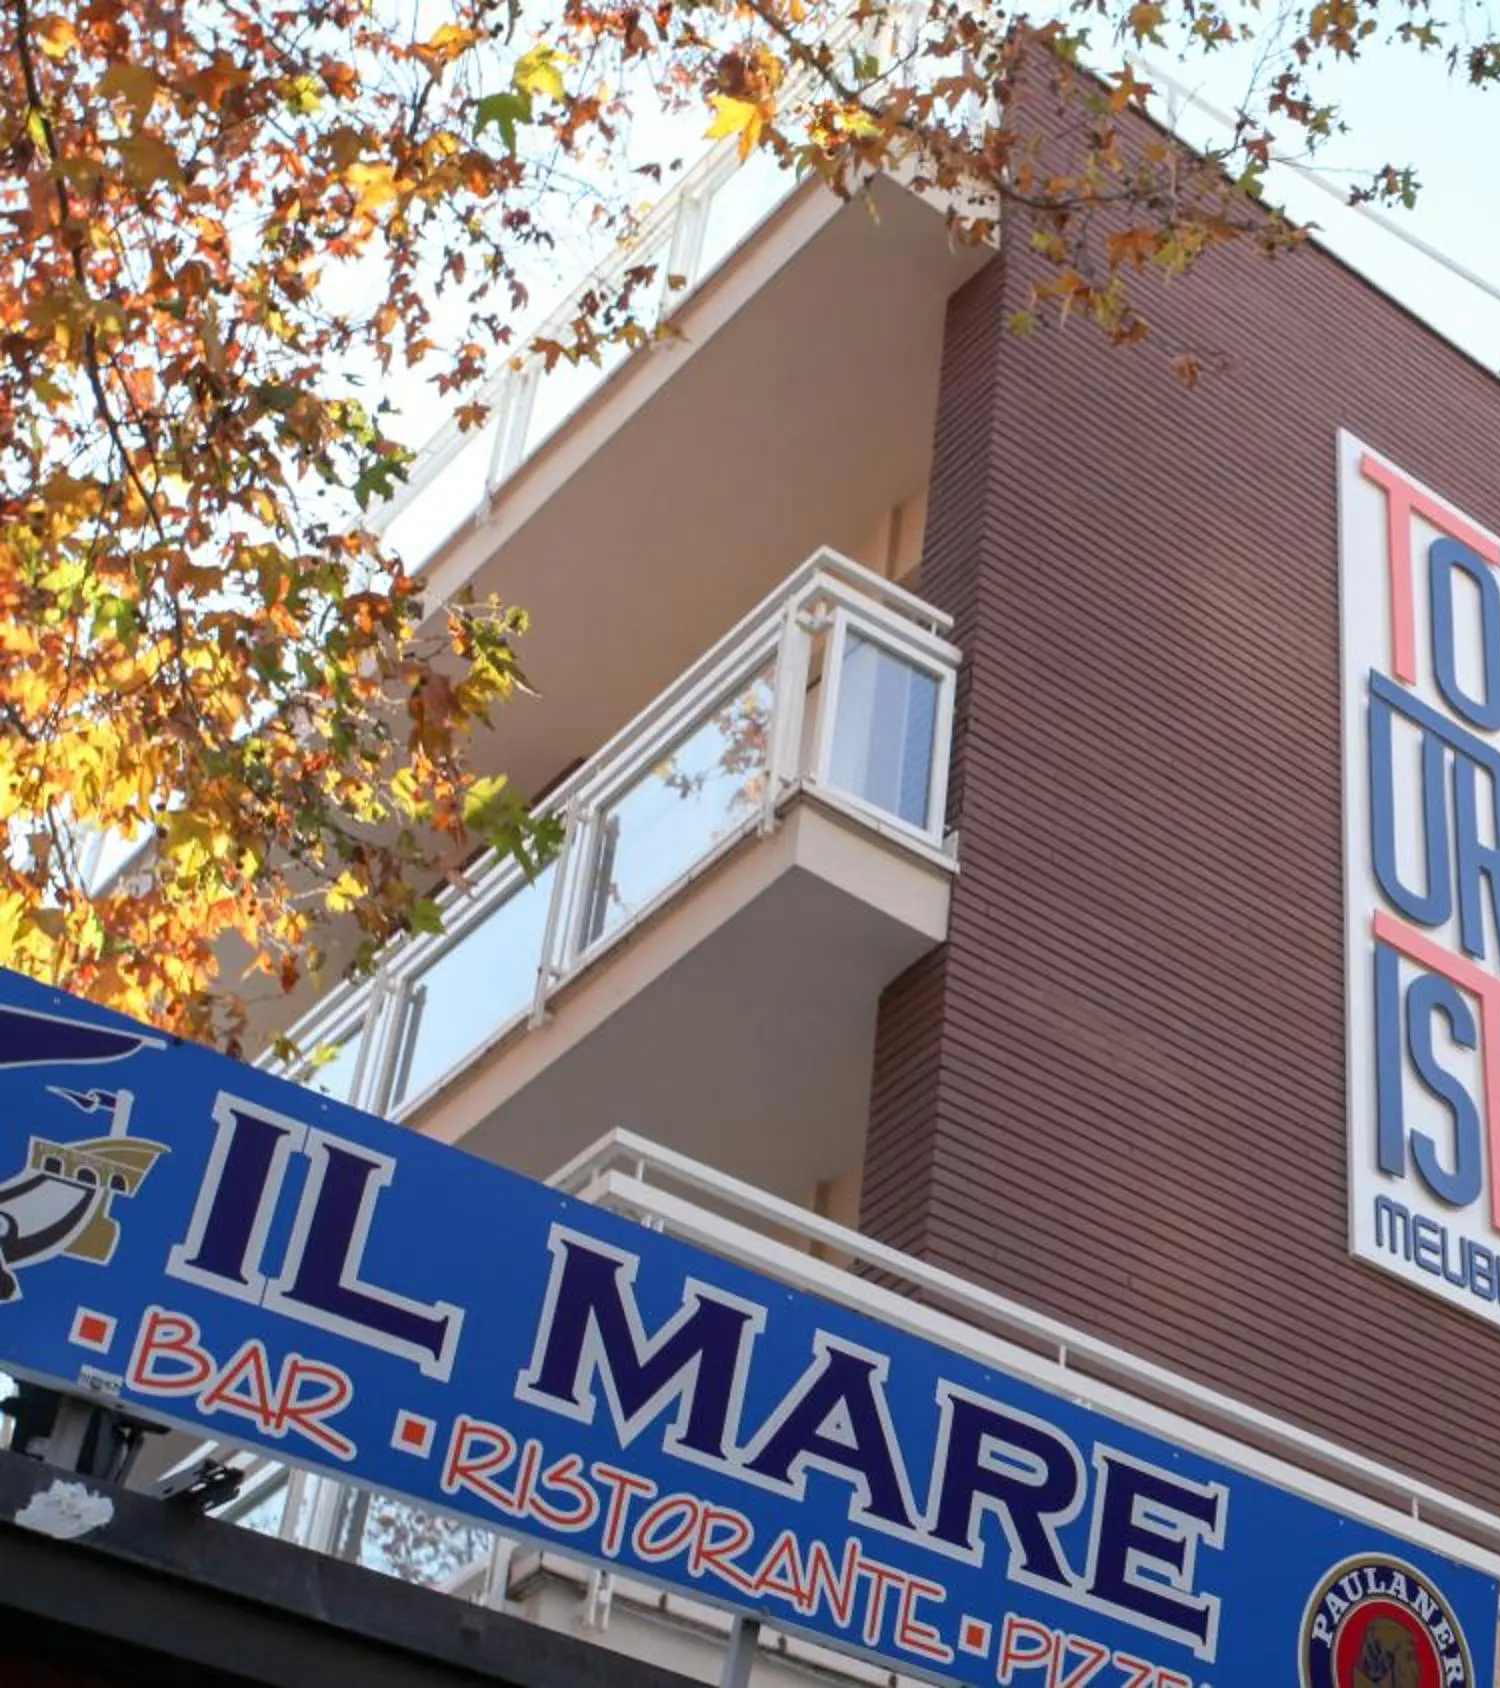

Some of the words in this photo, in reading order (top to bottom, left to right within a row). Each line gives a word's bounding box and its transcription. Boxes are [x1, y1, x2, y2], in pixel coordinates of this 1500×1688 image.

[128, 1305, 356, 1460] BAR
[441, 1415, 953, 1661] RISTORANTE
[165, 1090, 466, 1382] IL
[514, 1222, 1229, 1662] MARE
[1312, 1567, 1465, 1684] PAULANER
